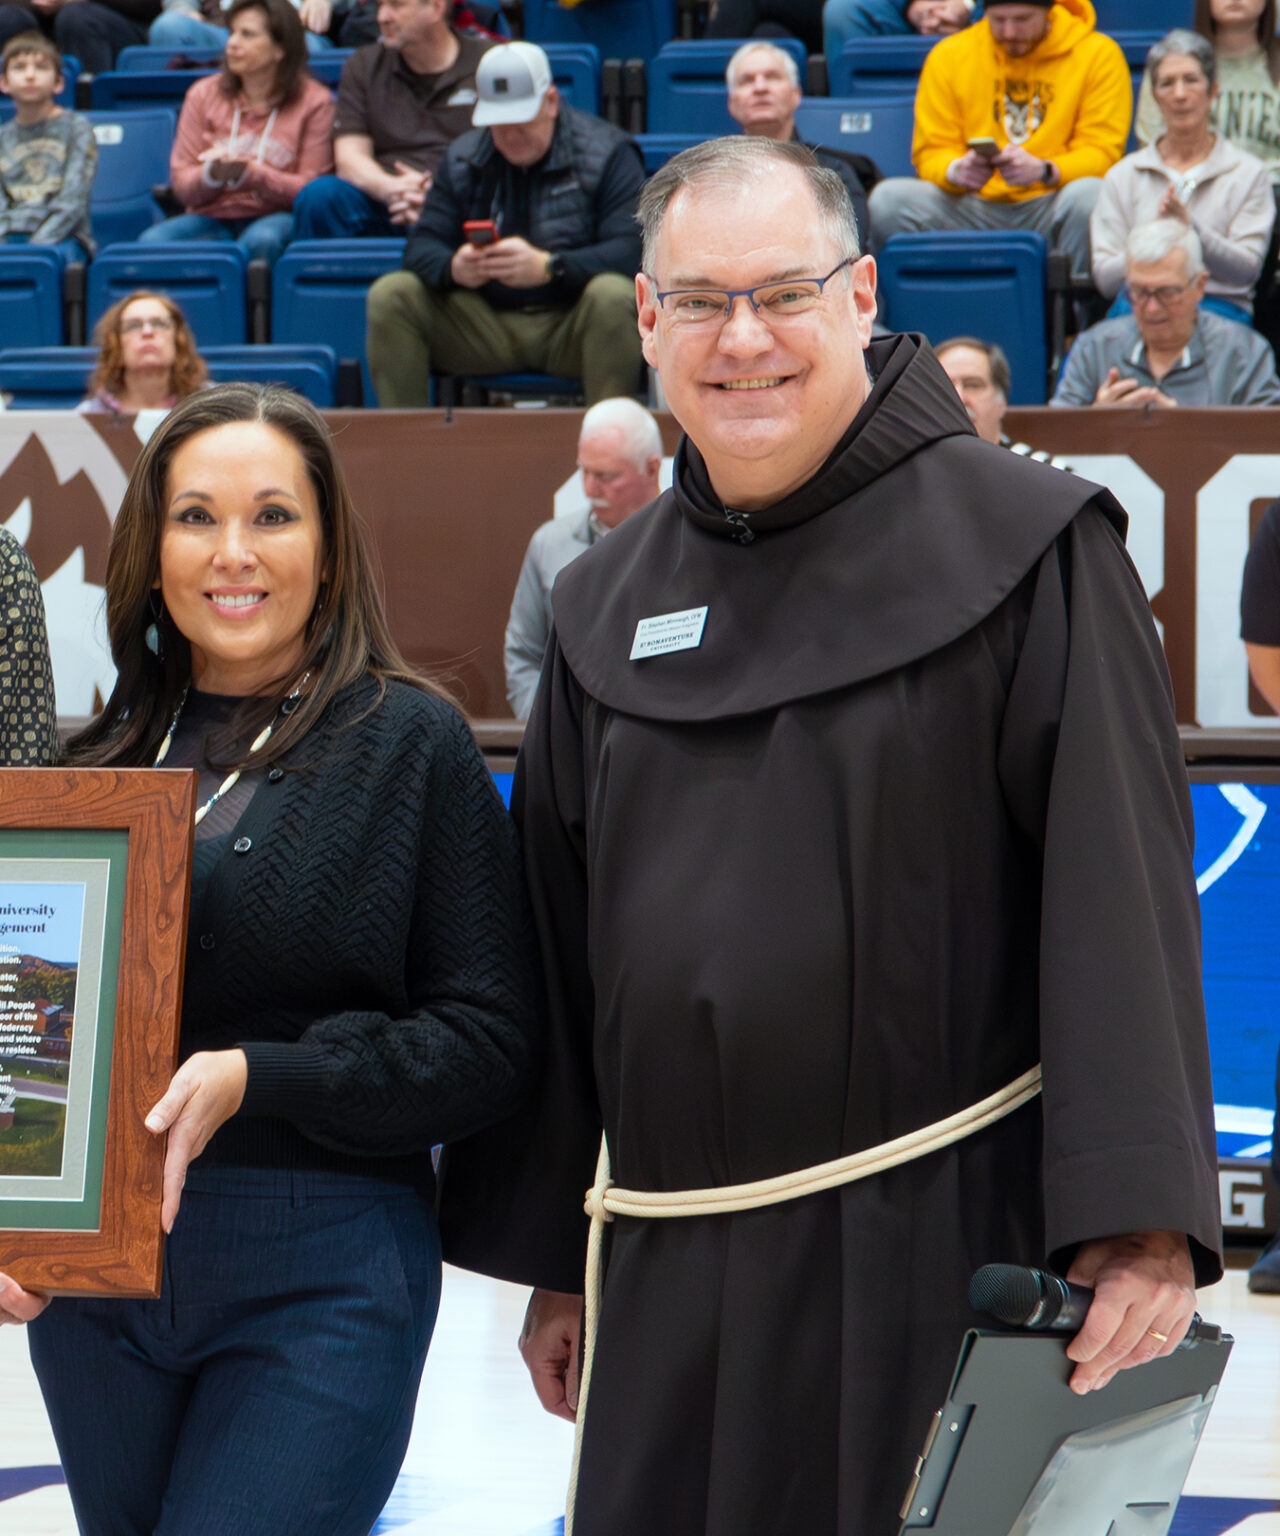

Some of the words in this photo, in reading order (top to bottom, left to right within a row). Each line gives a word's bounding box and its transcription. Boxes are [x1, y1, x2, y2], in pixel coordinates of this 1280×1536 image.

[647, 632, 694, 647] BONAVENTURE
[7, 1001, 36, 1012] People
[14, 1011, 24, 1021] of
[24, 1012, 38, 1021] the
[15, 1034, 41, 1043] where
[4, 1045, 38, 1054] resides.
